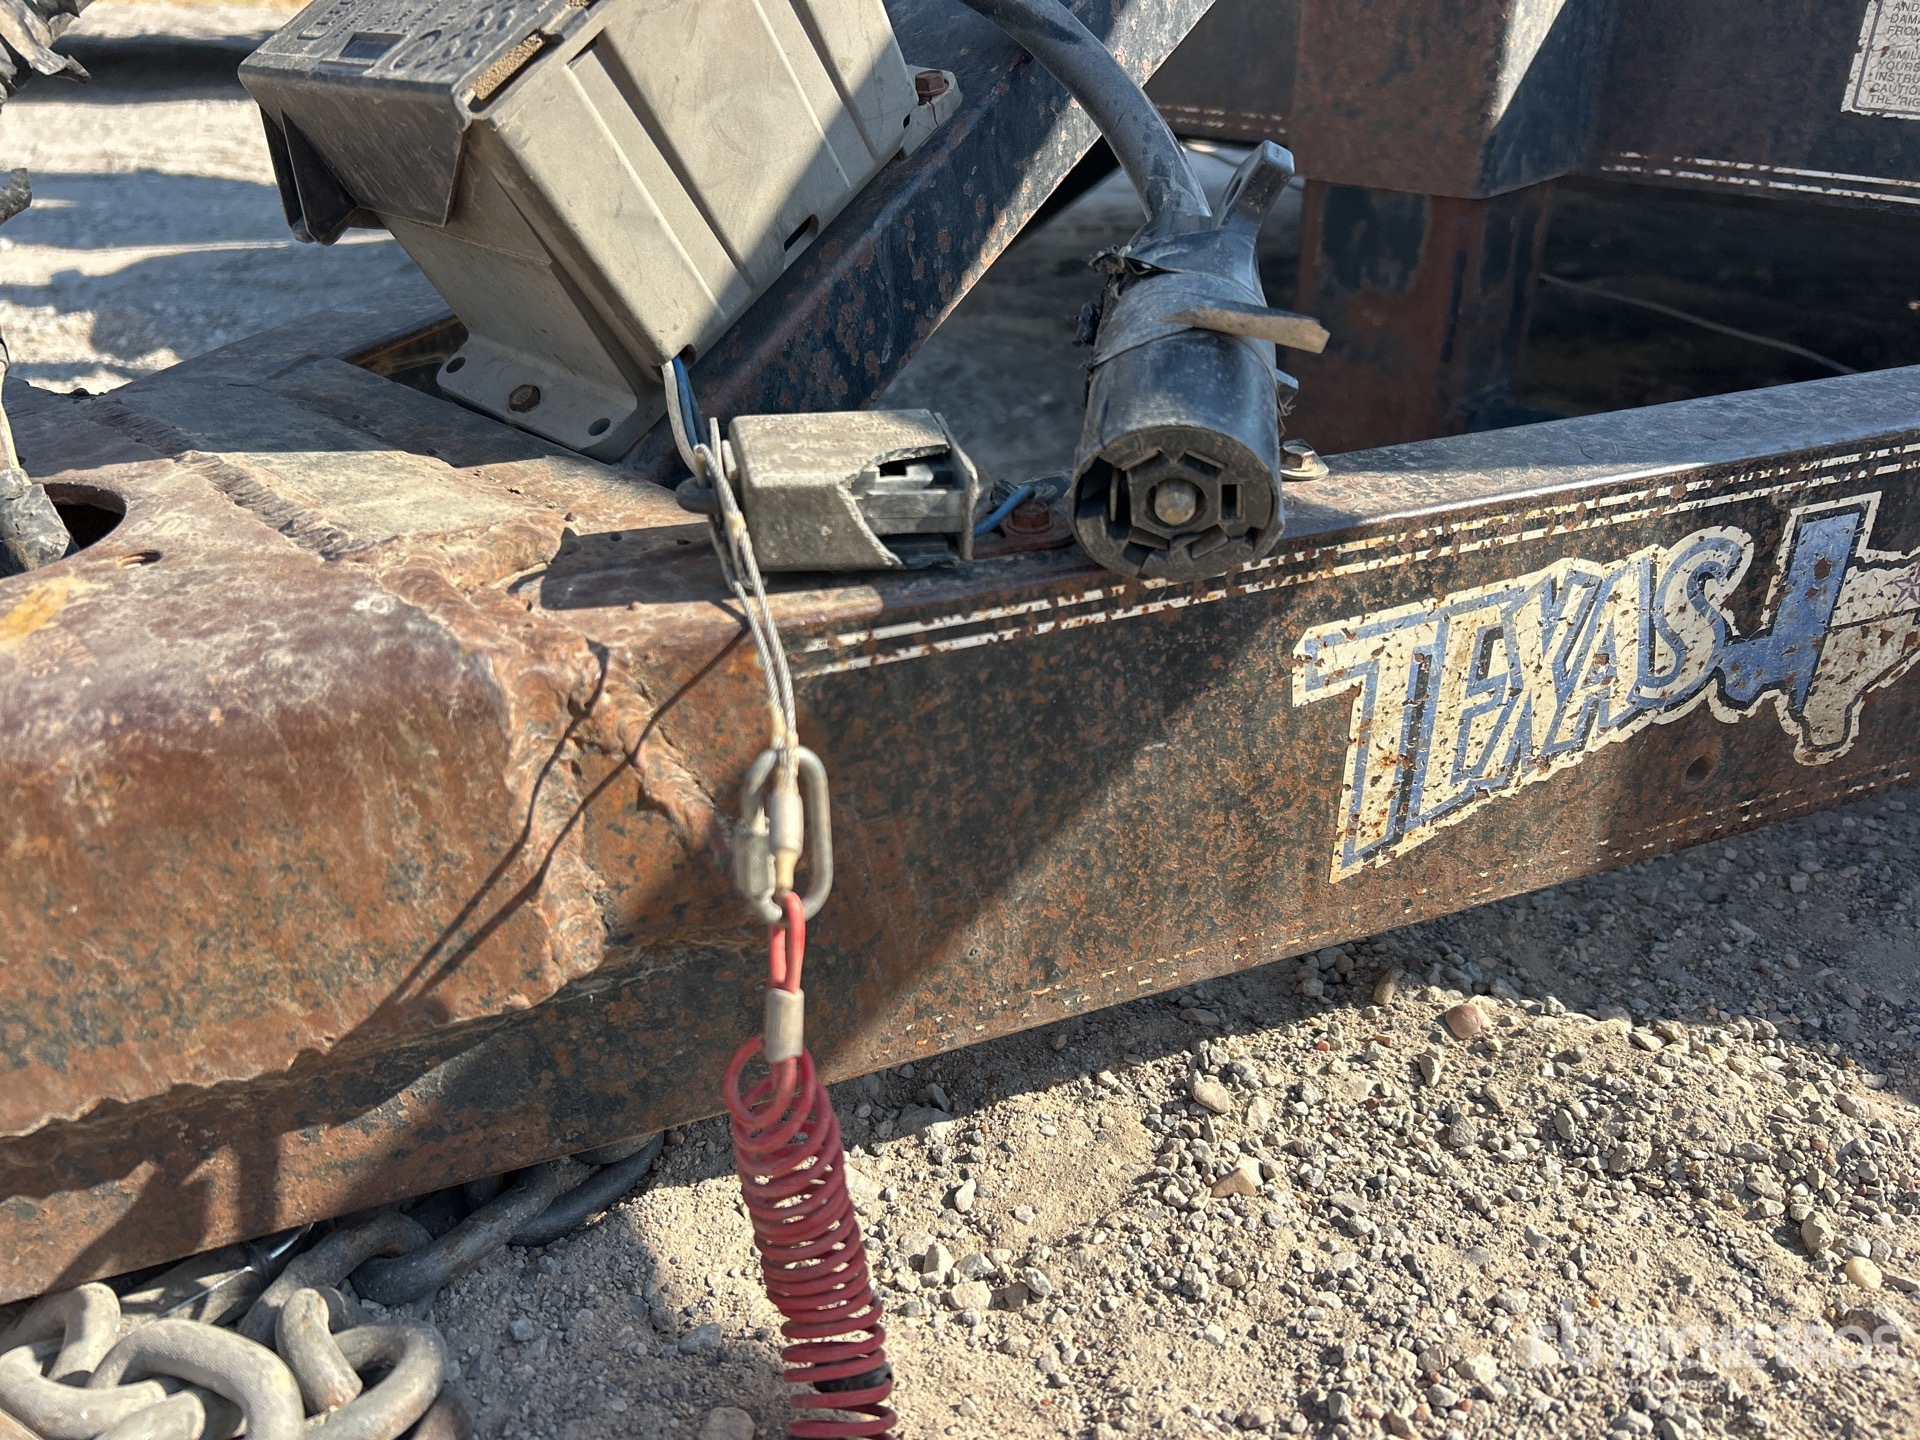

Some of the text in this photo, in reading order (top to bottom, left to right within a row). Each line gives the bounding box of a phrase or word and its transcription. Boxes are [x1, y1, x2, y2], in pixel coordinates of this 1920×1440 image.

[1893, 2, 1920, 12] AND
[1883, 50, 1920, 60] AMIL
[1879, 60, 1920, 72] YOURS
[1875, 72, 1920, 83] INSTRU
[1872, 82, 1920, 95] CAUTIO
[1870, 94, 1892, 105] THE
[1292, 525, 1755, 885] TEXAS
